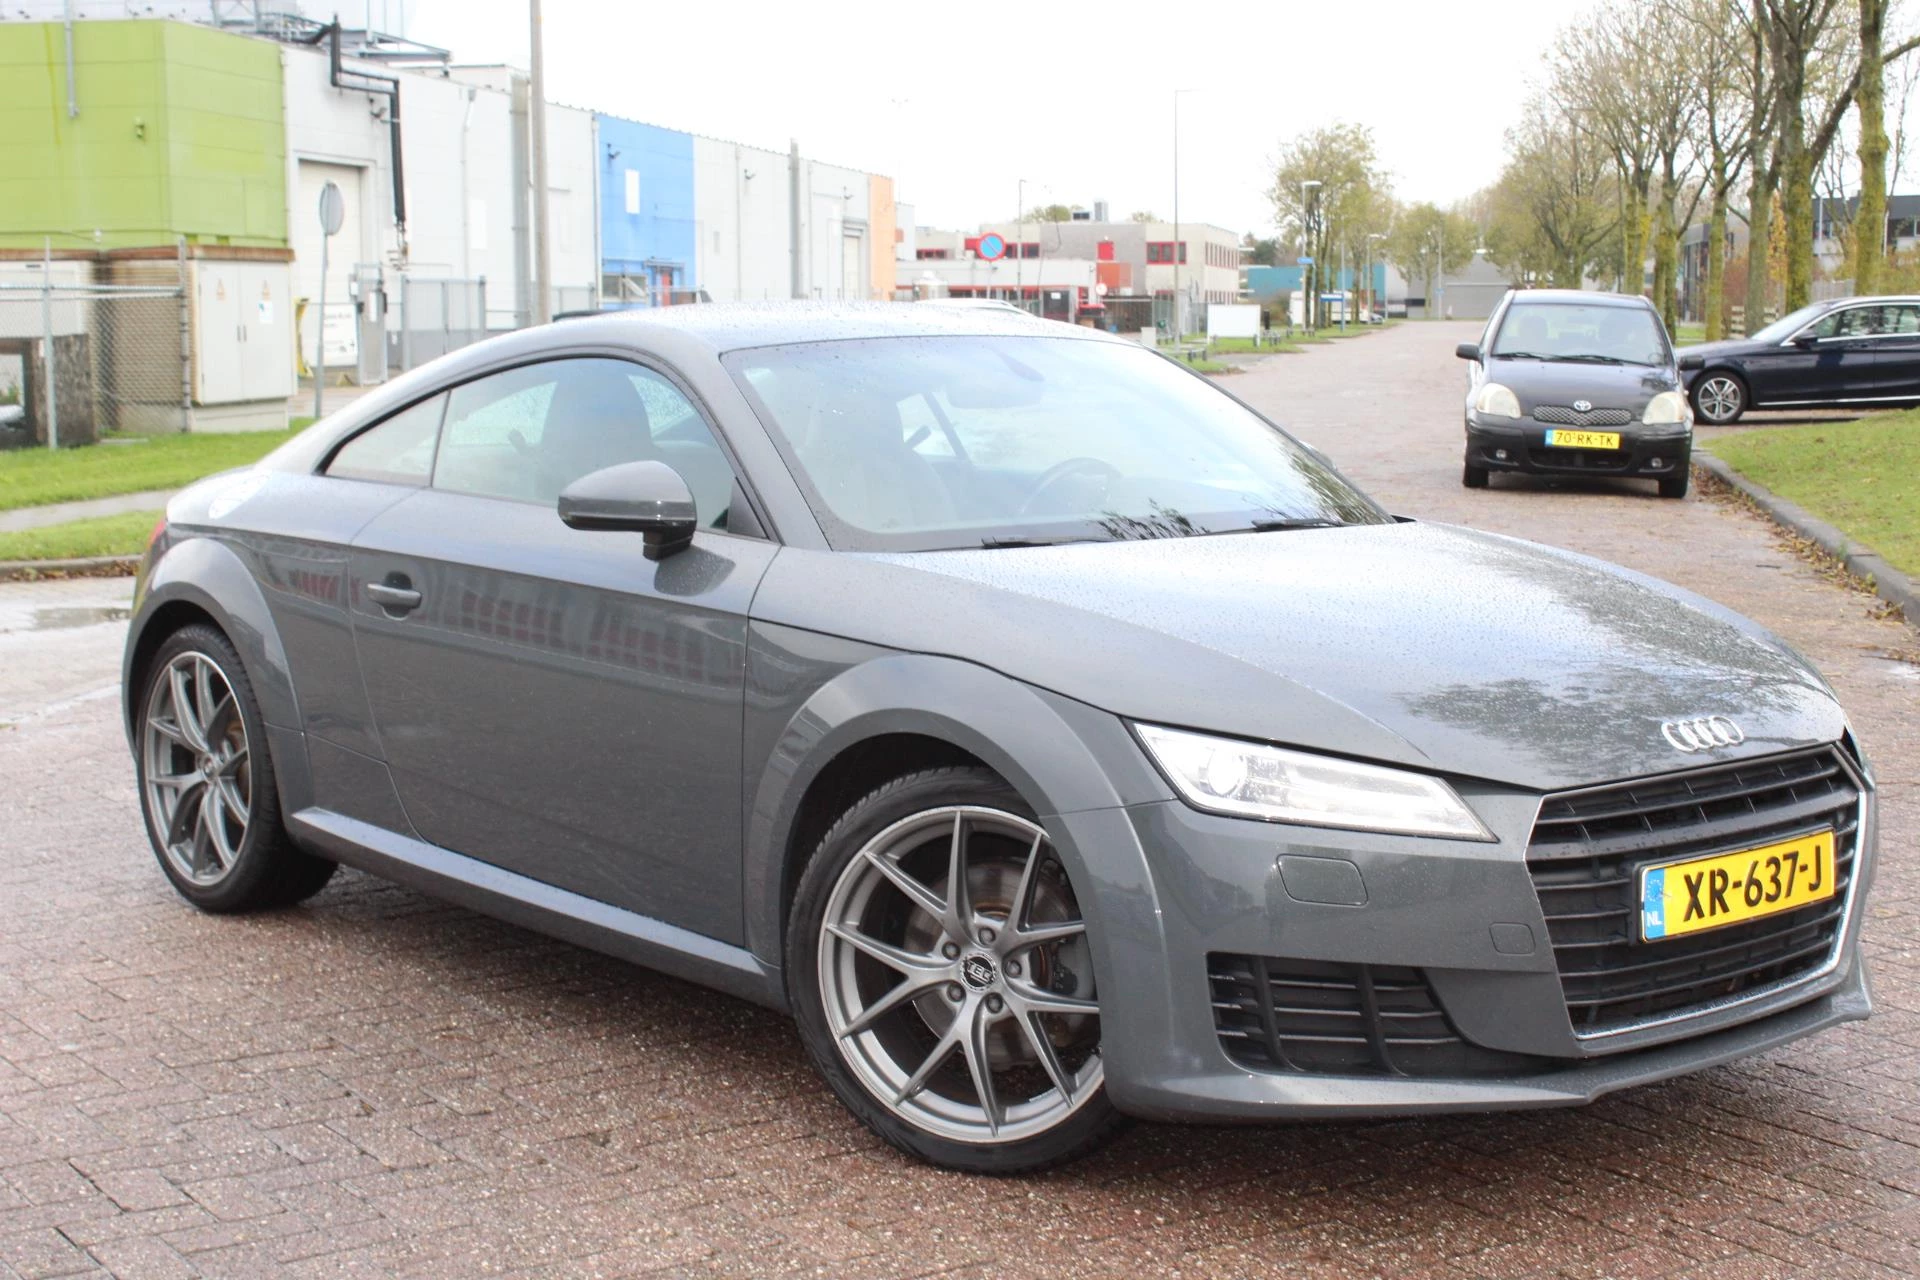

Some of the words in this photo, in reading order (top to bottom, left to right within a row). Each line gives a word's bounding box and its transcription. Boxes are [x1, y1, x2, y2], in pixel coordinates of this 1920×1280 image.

[1556, 432, 1613, 447] 70-RK-TK
[1683, 845, 1822, 922] XR-637-J
[1646, 911, 1662, 927] NL
